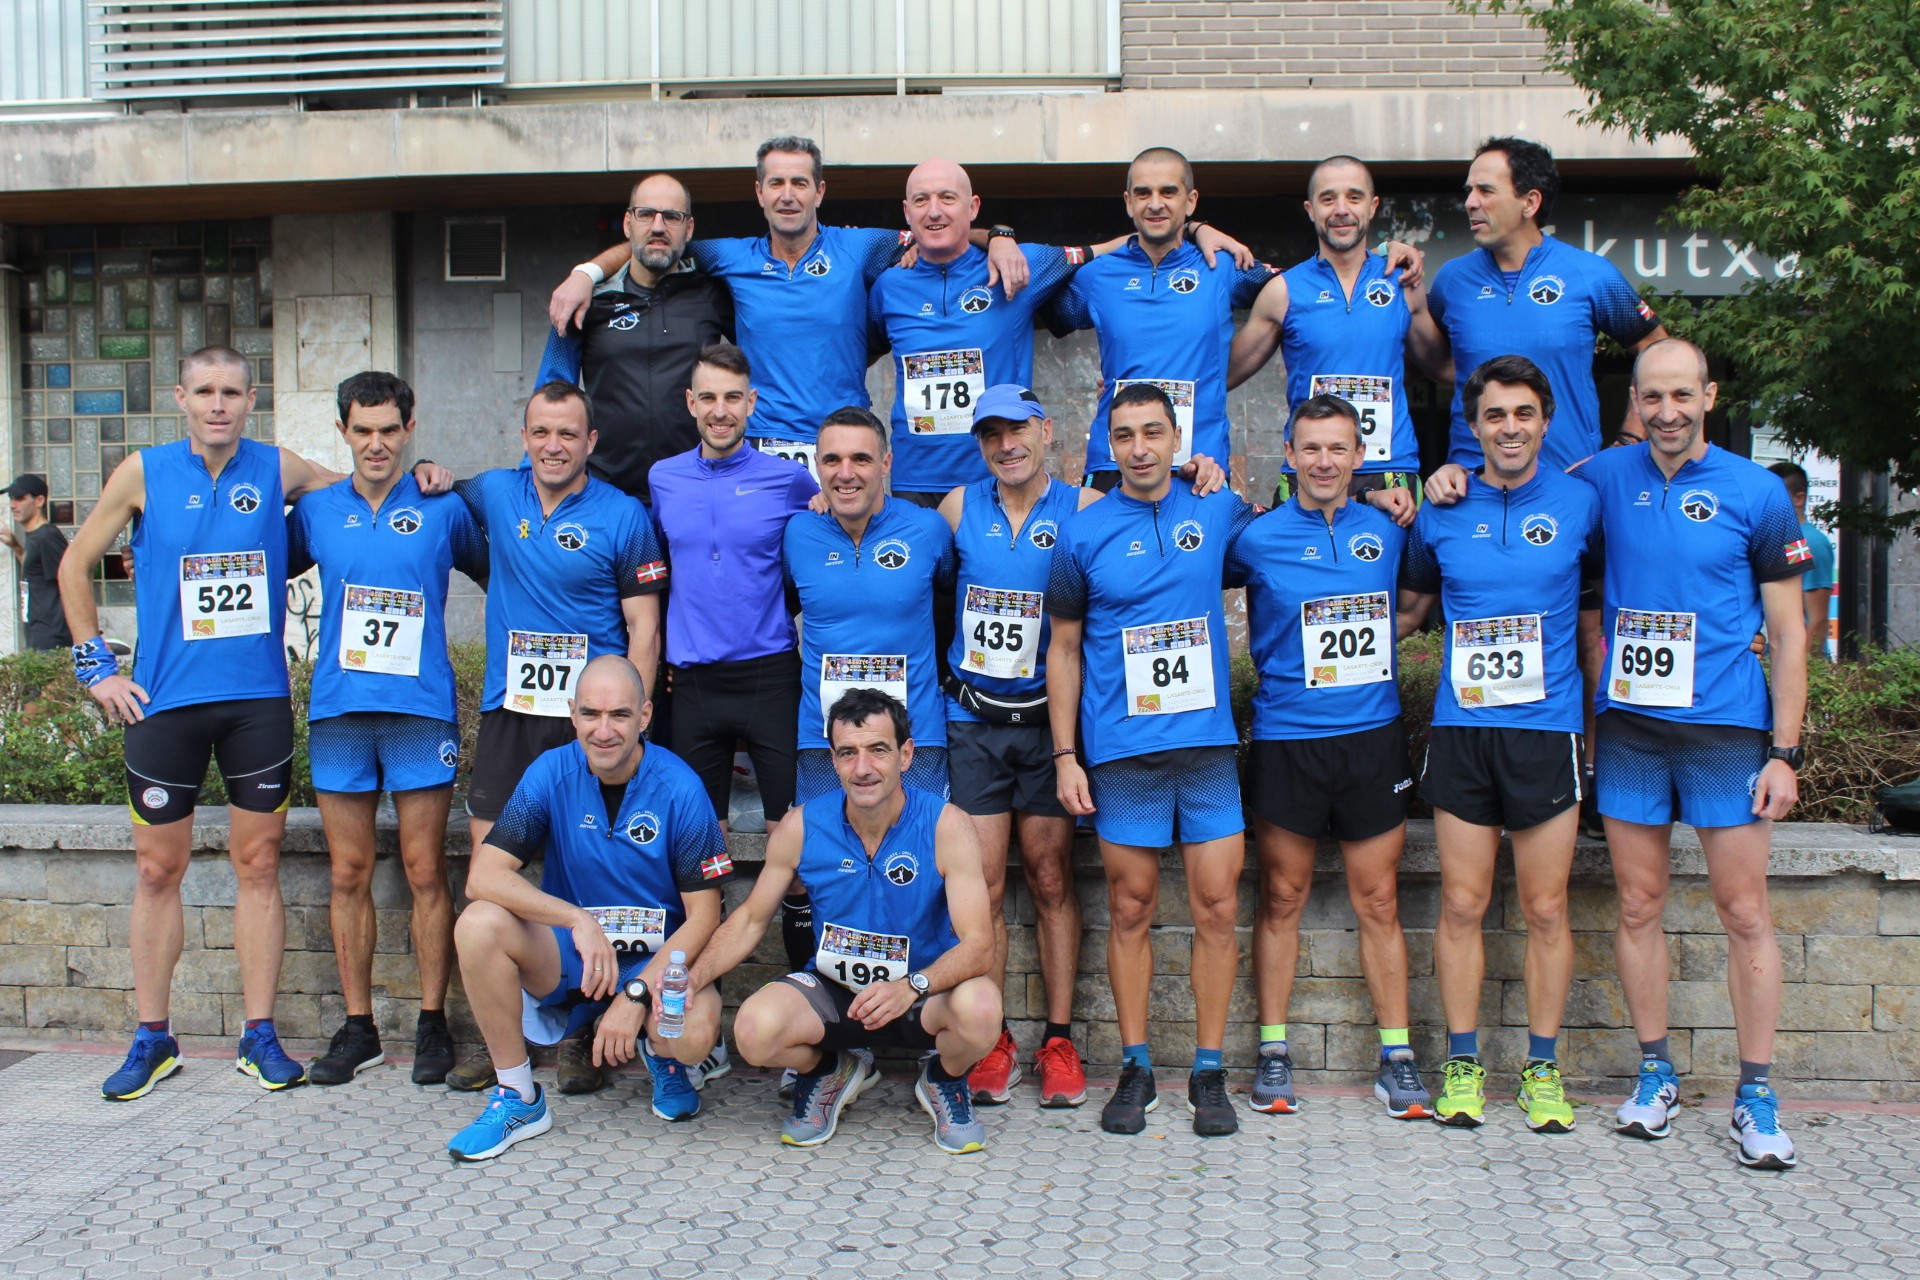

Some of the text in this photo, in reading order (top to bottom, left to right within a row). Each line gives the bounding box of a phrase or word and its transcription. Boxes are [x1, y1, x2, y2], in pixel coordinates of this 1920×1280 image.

[1584, 219, 1803, 278] kutxa
[921, 381, 972, 411] 178
[198, 583, 254, 614] 522
[363, 618, 400, 648] 37
[972, 620, 1024, 653] 435
[1319, 627, 1376, 660] 202
[1152, 655, 1189, 688] 84
[1467, 650, 1524, 681] 633
[1621, 644, 1674, 678] 699
[520, 663, 572, 692] 207
[835, 960, 890, 986] 198
